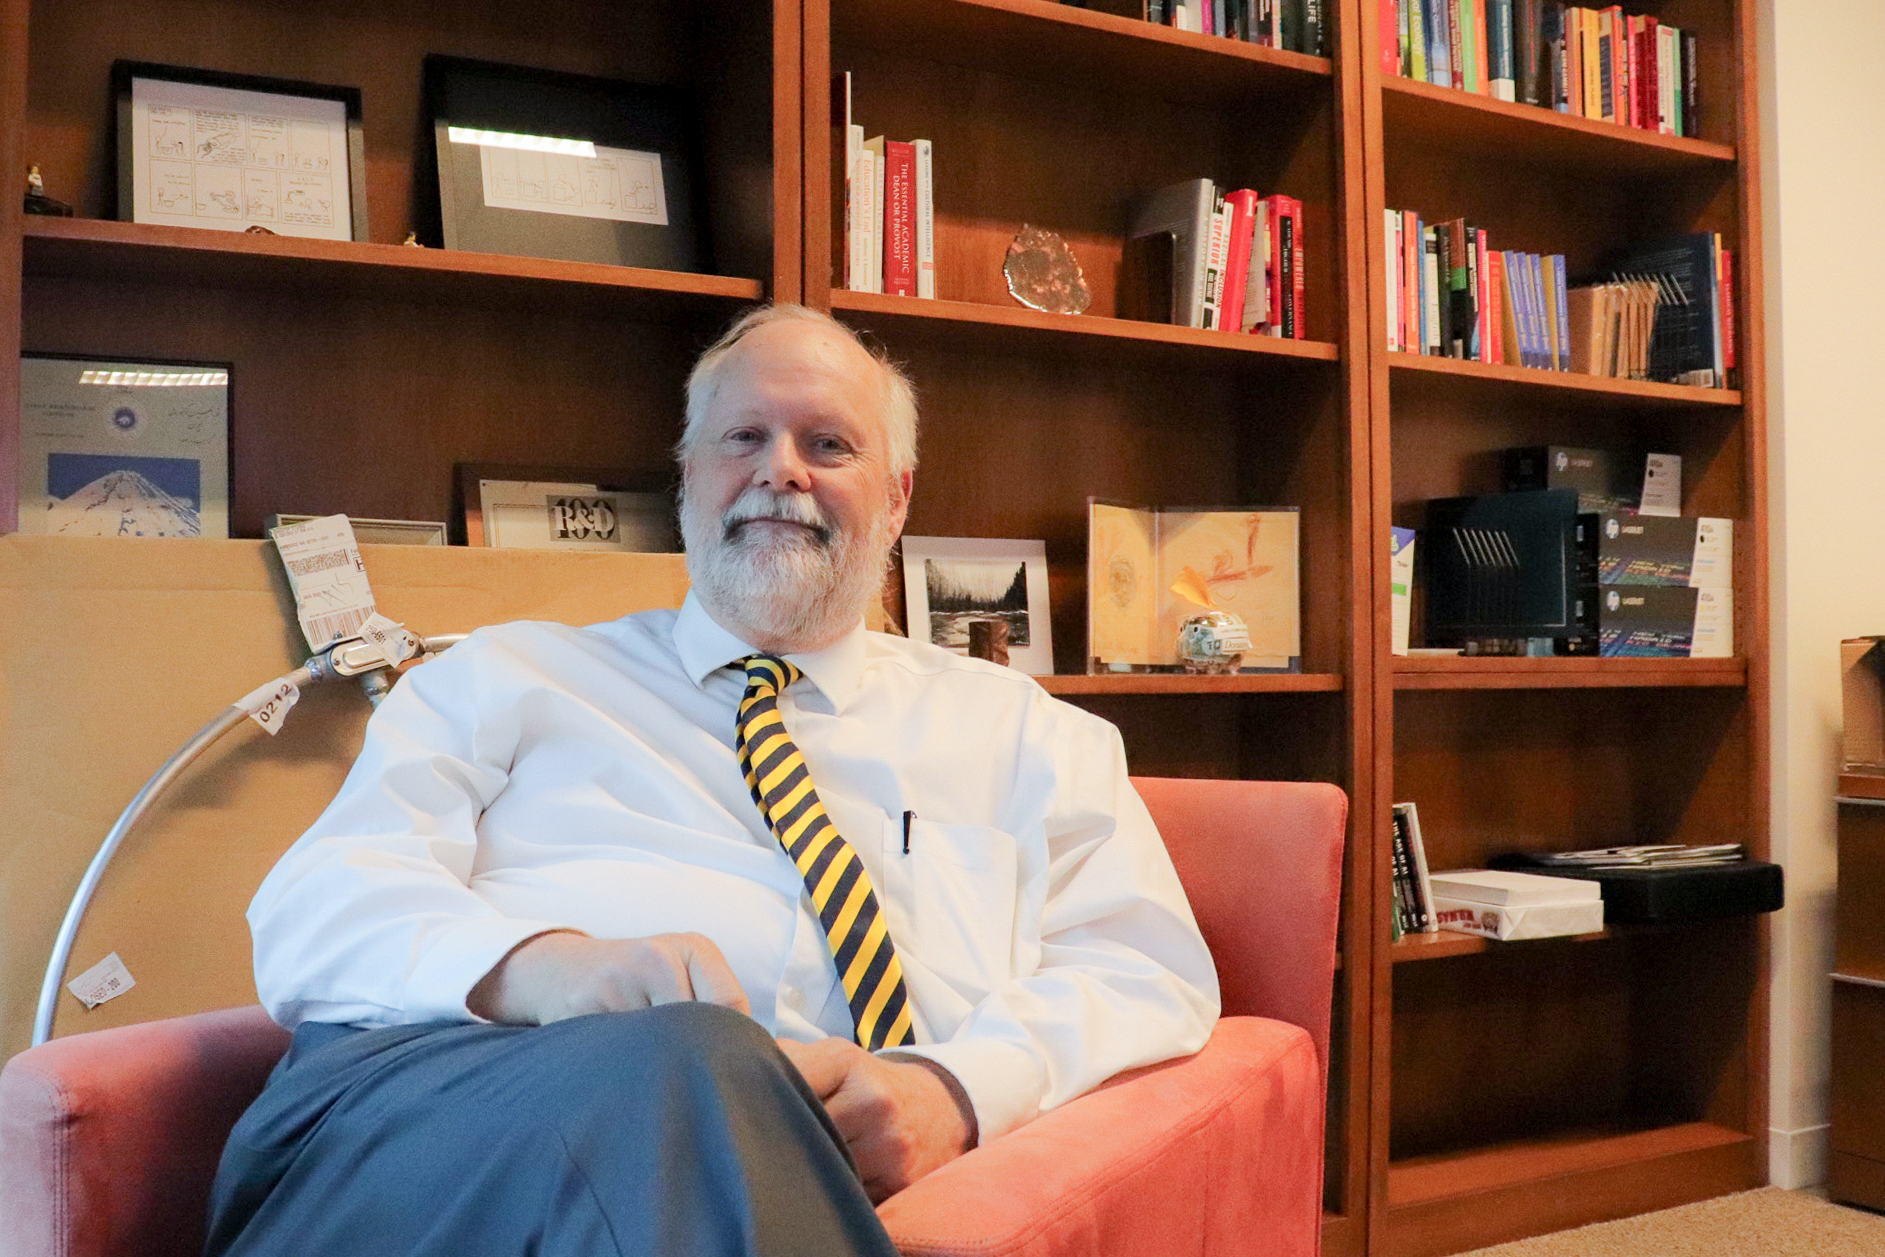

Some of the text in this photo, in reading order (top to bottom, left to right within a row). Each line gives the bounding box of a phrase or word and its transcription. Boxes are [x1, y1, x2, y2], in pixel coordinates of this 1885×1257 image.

[1307, 0, 1317, 23] LIFE
[1412, 16, 1422, 56] Ecology
[863, 159, 872, 233] Education's End
[893, 202, 900, 215] OR
[1211, 218, 1223, 266] SUPERIOR
[1216, 234, 1228, 308] RADICAL INCLUSION
[553, 505, 615, 532] R&D
[259, 683, 293, 723] 0212
[1396, 838, 1404, 853] AGE
[1400, 854, 1406, 864] OF
[1402, 866, 1409, 875] AI
